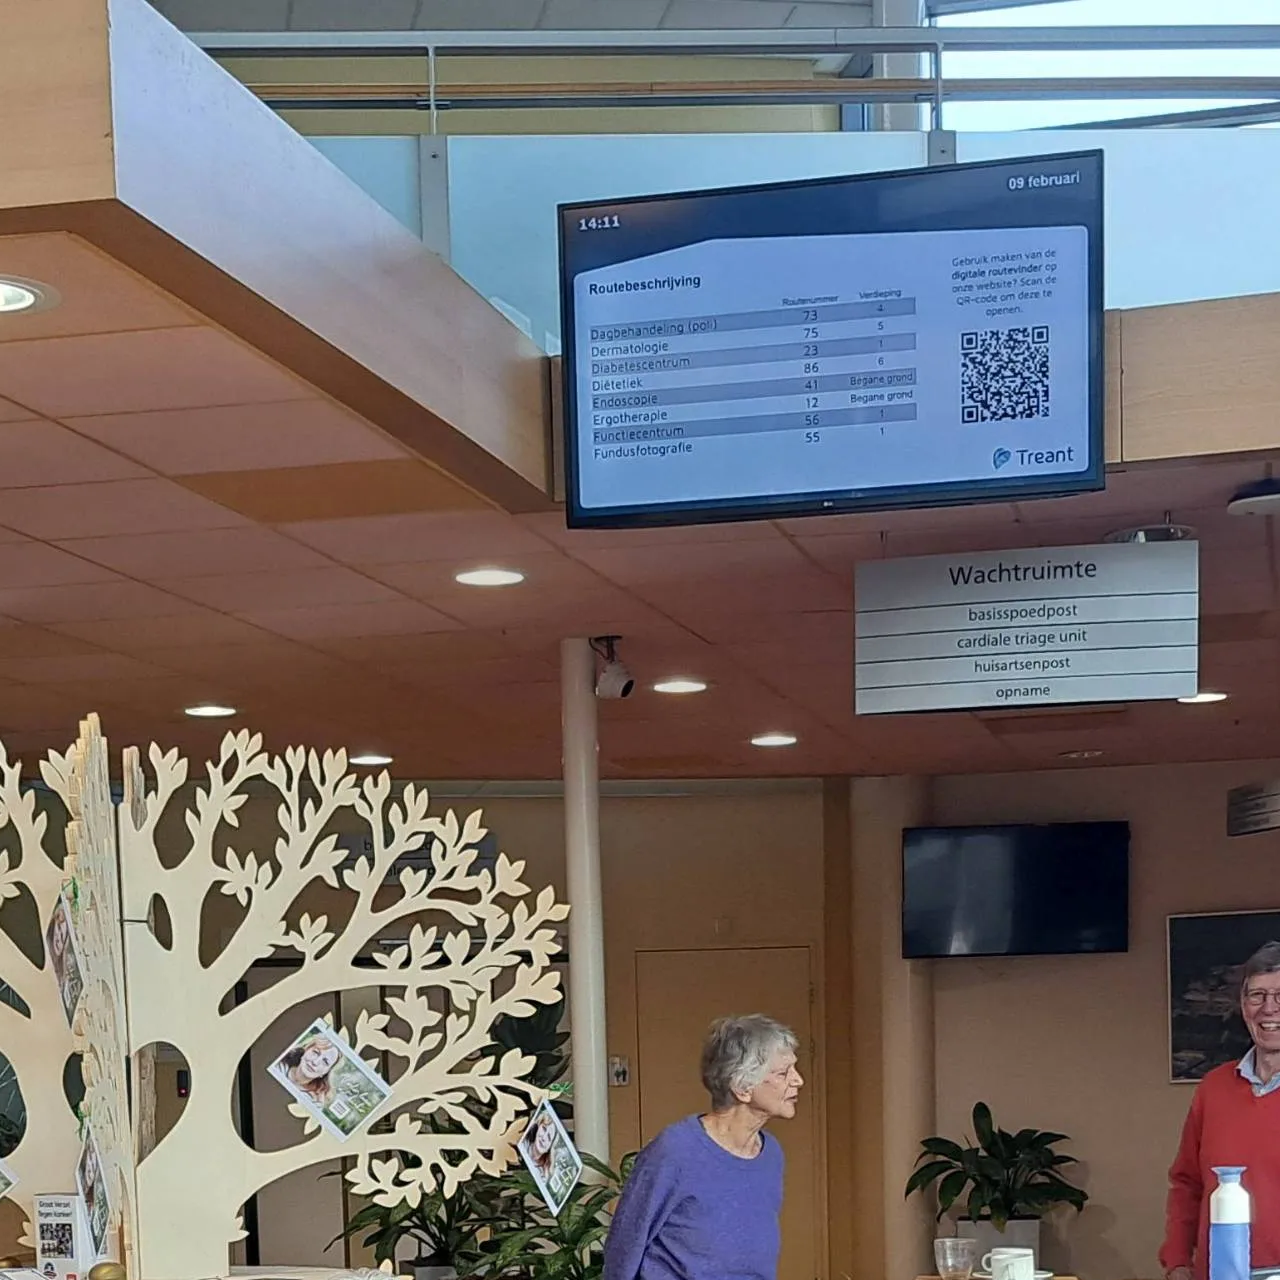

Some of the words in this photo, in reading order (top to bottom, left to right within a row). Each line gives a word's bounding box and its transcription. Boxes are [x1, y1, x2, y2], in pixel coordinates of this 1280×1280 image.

[1008, 177, 1024, 190] 09
[1028, 170, 1080, 188] februari
[579, 215, 620, 230] 14:11
[952, 256, 988, 267] Gebruik
[991, 252, 1022, 262] maken
[1024, 251, 1042, 259] van
[1044, 248, 1056, 258] de
[952, 268, 986, 281] digitale
[988, 263, 1042, 276] routevinder
[1044, 263, 1057, 272] op
[589, 275, 701, 295] Routebeschrijving
[858, 288, 902, 299] Verdieping
[952, 284, 973, 293] onze
[976, 280, 1017, 290] website?
[1019, 277, 1043, 287] Scan
[1045, 275, 1057, 284] de
[956, 294, 997, 306] QR-code
[1000, 293, 1015, 301] om
[1018, 290, 1040, 300] deze
[1043, 289, 1052, 298] te
[986, 306, 1023, 317] openen.
[591, 321, 684, 341] Dagbehandeling
[688, 319, 717, 334] (poli)
[803, 310, 818, 321] 73
[592, 341, 669, 357] Dermatologie
[803, 327, 819, 338] 75
[877, 321, 884, 330] 5
[592, 357, 691, 374] Diabetescentrum
[803, 345, 818, 356] 23
[804, 362, 819, 374] 86
[878, 357, 884, 365] 6
[593, 393, 658, 409] Endoscopie
[804, 380, 818, 391] 41
[850, 374, 885, 387] Begane
[887, 372, 913, 385] grond
[593, 410, 668, 427] Ergotherapie
[806, 397, 818, 408] 12
[850, 392, 885, 405] Begane
[887, 390, 913, 402] grond
[593, 426, 684, 443] Functiecentrum
[805, 414, 819, 425] 56
[594, 442, 693, 460] Fundusfotografie
[805, 432, 820, 443] 55
[1016, 446, 1074, 466] Treant
[949, 559, 1097, 586] Wachtruimte
[968, 603, 1078, 623] basisspoedpost
[956, 632, 1011, 650] cardiale
[1014, 630, 1055, 648] triage
[1059, 629, 1087, 644] unit
[974, 656, 1071, 675] huisartsenpost
[996, 685, 1051, 700] opname
